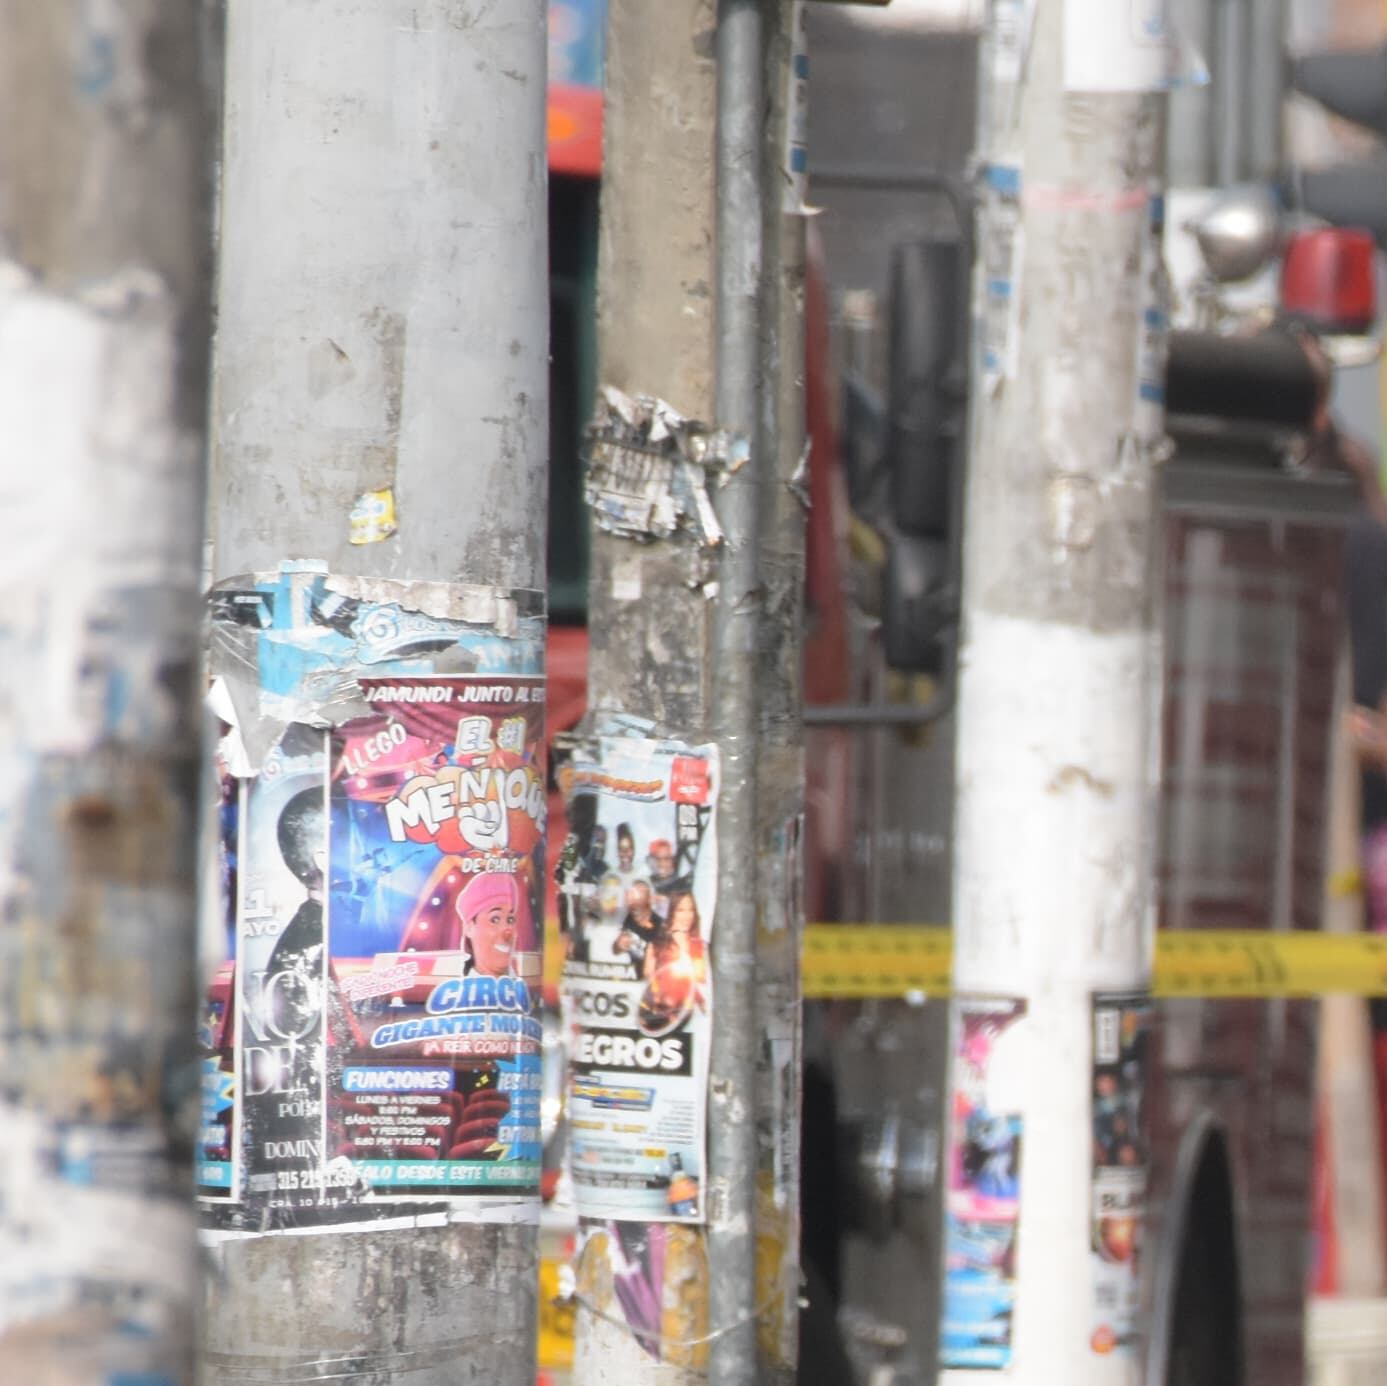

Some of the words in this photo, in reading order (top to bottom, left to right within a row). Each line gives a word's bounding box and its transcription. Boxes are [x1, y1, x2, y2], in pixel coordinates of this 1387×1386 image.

[457, 686, 513, 703] JUNTO
[343, 715, 408, 776] LLEGÓ
[461, 857, 482, 873] DE
[371, 1013, 487, 1048] GIGANTE
[346, 1070, 451, 1090] FUNCIONES
[355, 1095, 388, 1105] LUNES
[390, 1095, 398, 1105] A
[400, 1095, 441, 1105] VIERNES
[400, 1106, 418, 1114] PM
[397, 1116, 451, 1126] DOMINGOS
[369, 1127, 379, 1136] Y
[380, 1127, 426, 1136] FESTIVOS
[376, 1137, 393, 1146] PM
[424, 1137, 441, 1146] PM
[396, 1165, 446, 1181] DESDE
[450, 1165, 482, 1180] ESTE
